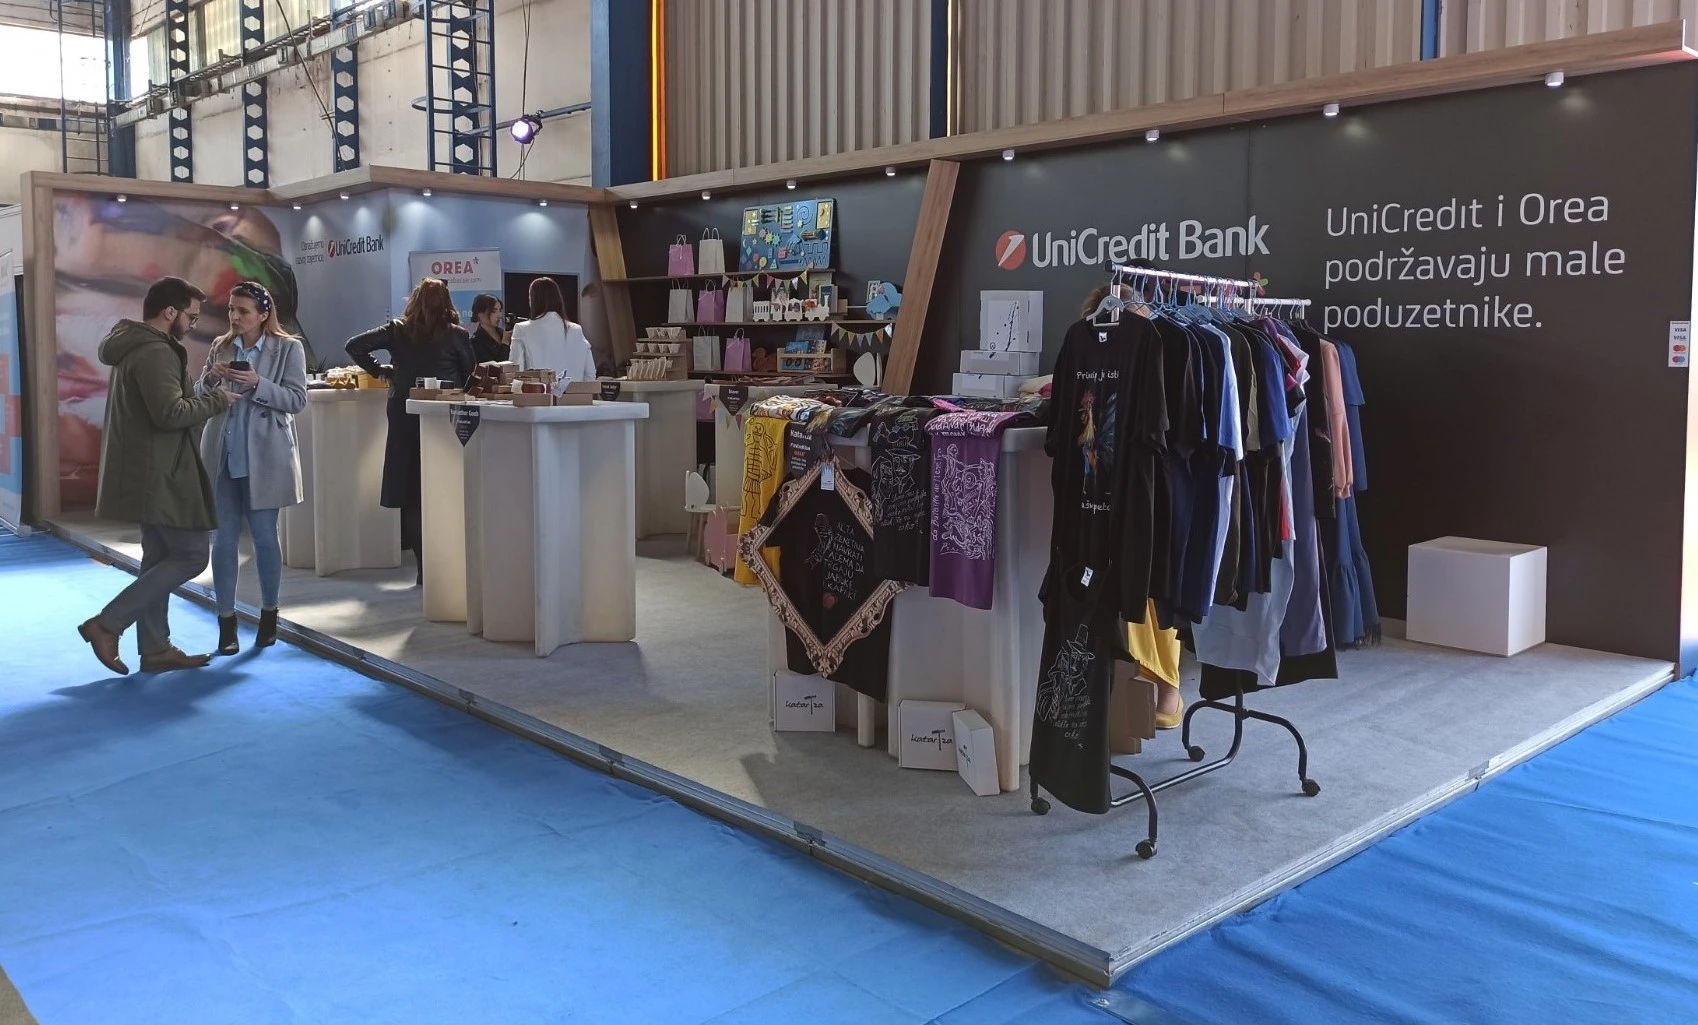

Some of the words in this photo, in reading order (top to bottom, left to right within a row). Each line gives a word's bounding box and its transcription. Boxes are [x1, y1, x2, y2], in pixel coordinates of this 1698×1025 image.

[1496, 194, 1504, 228] i
[1518, 192, 1610, 226] Orea
[335, 236, 365, 257] UniCredit
[366, 234, 384, 253] Bank
[1032, 222, 1170, 268] UniCredit
[1178, 215, 1271, 260] Bank
[431, 260, 474, 275] OREA
[1324, 245, 1511, 290] podržavaju
[1525, 240, 1626, 277] male
[1322, 295, 1543, 335] poduzetnike.
